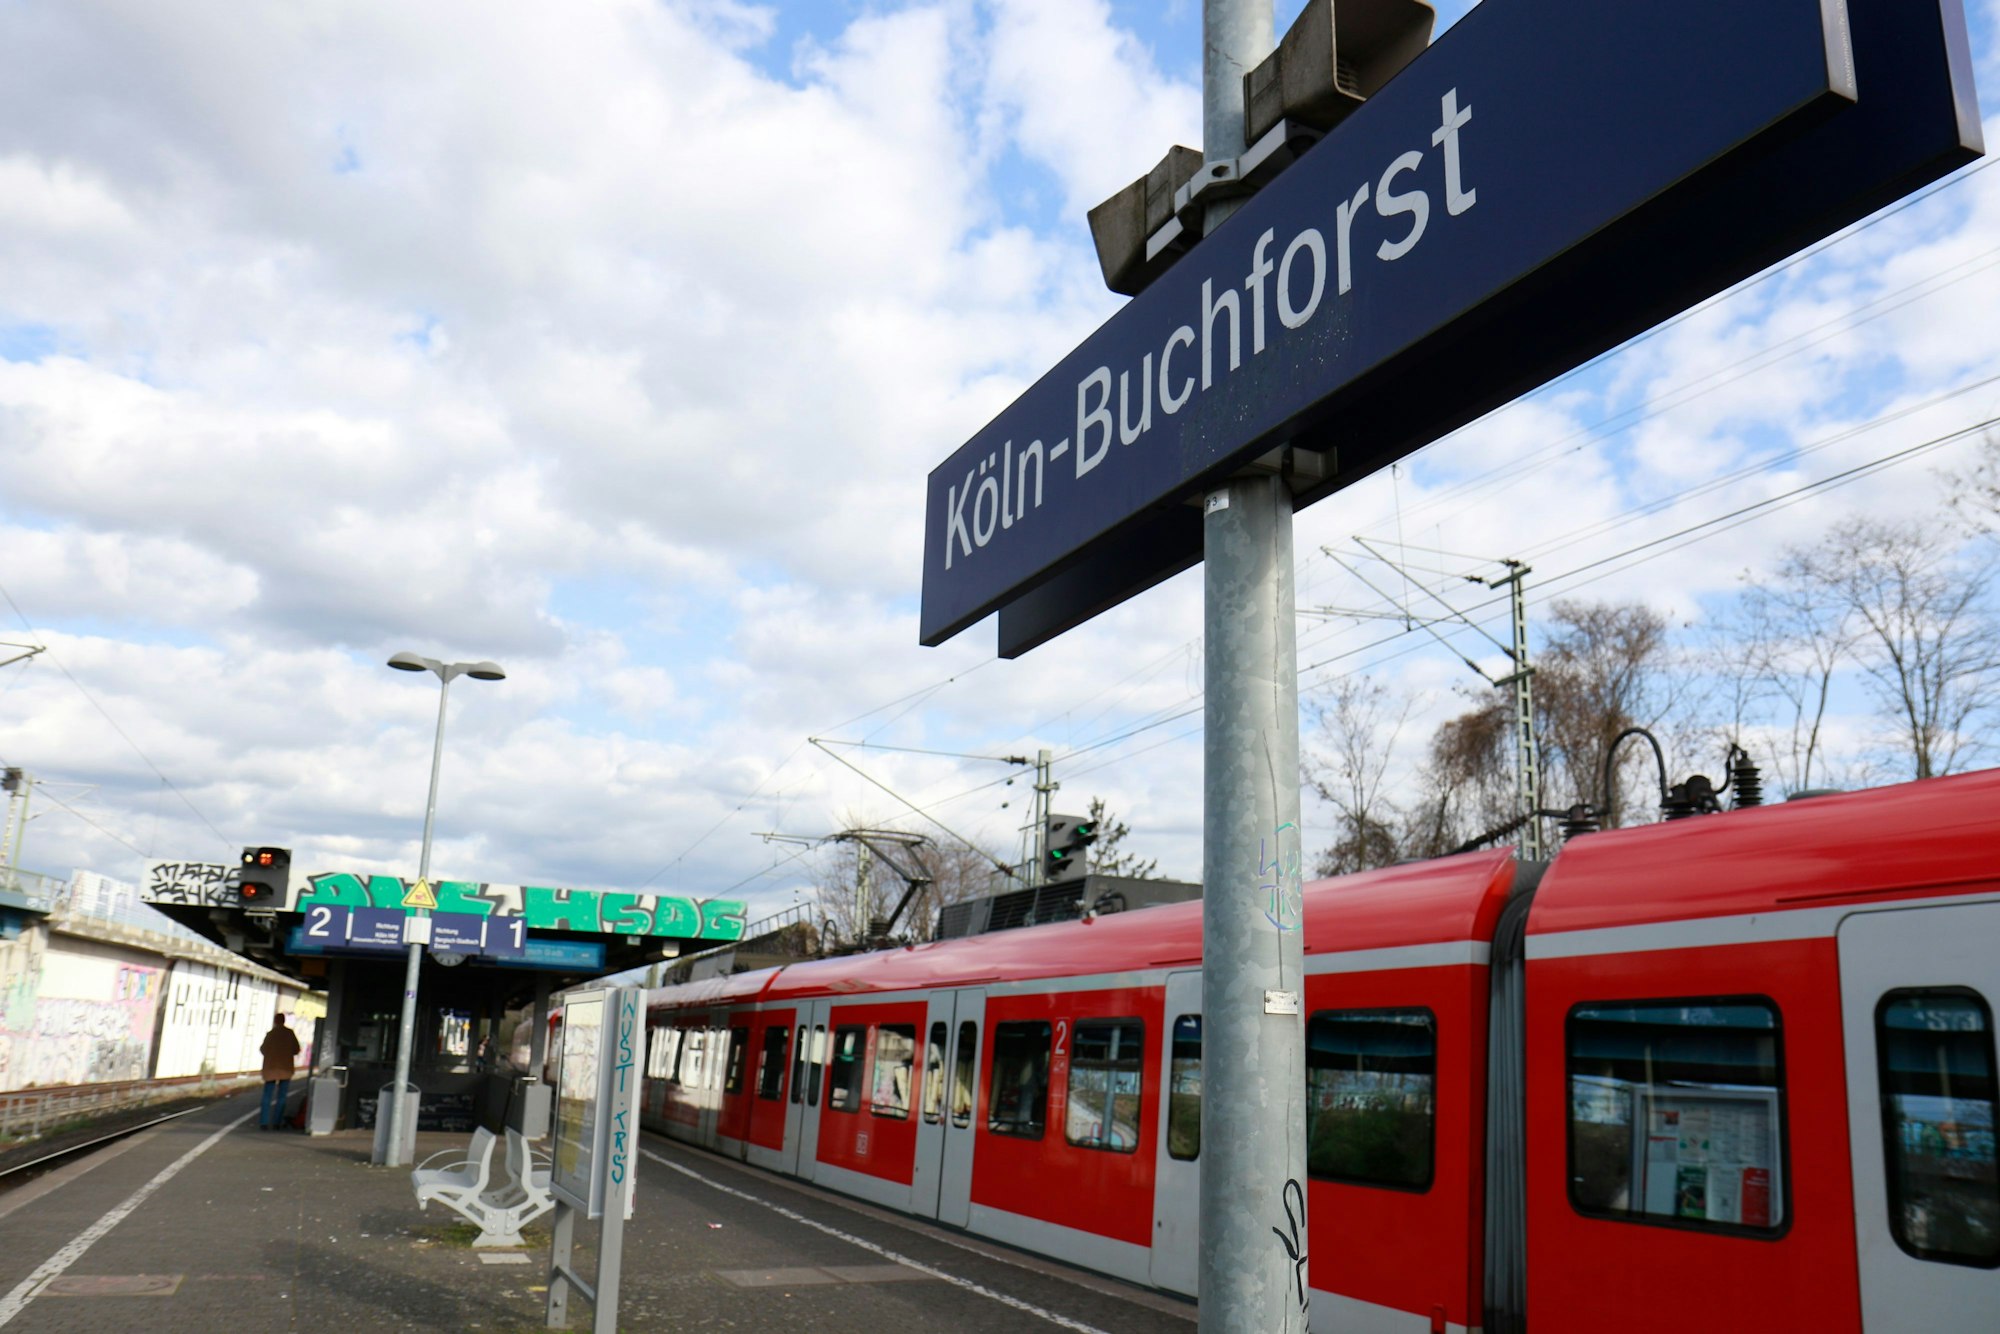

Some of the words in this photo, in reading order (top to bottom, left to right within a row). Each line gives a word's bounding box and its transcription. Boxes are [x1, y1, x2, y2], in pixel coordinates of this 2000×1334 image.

[945, 87, 1477, 570] Köln-Buchforst
[308, 906, 332, 937] 2
[509, 919, 523, 949] 1
[1054, 1020, 1068, 1055] 2
